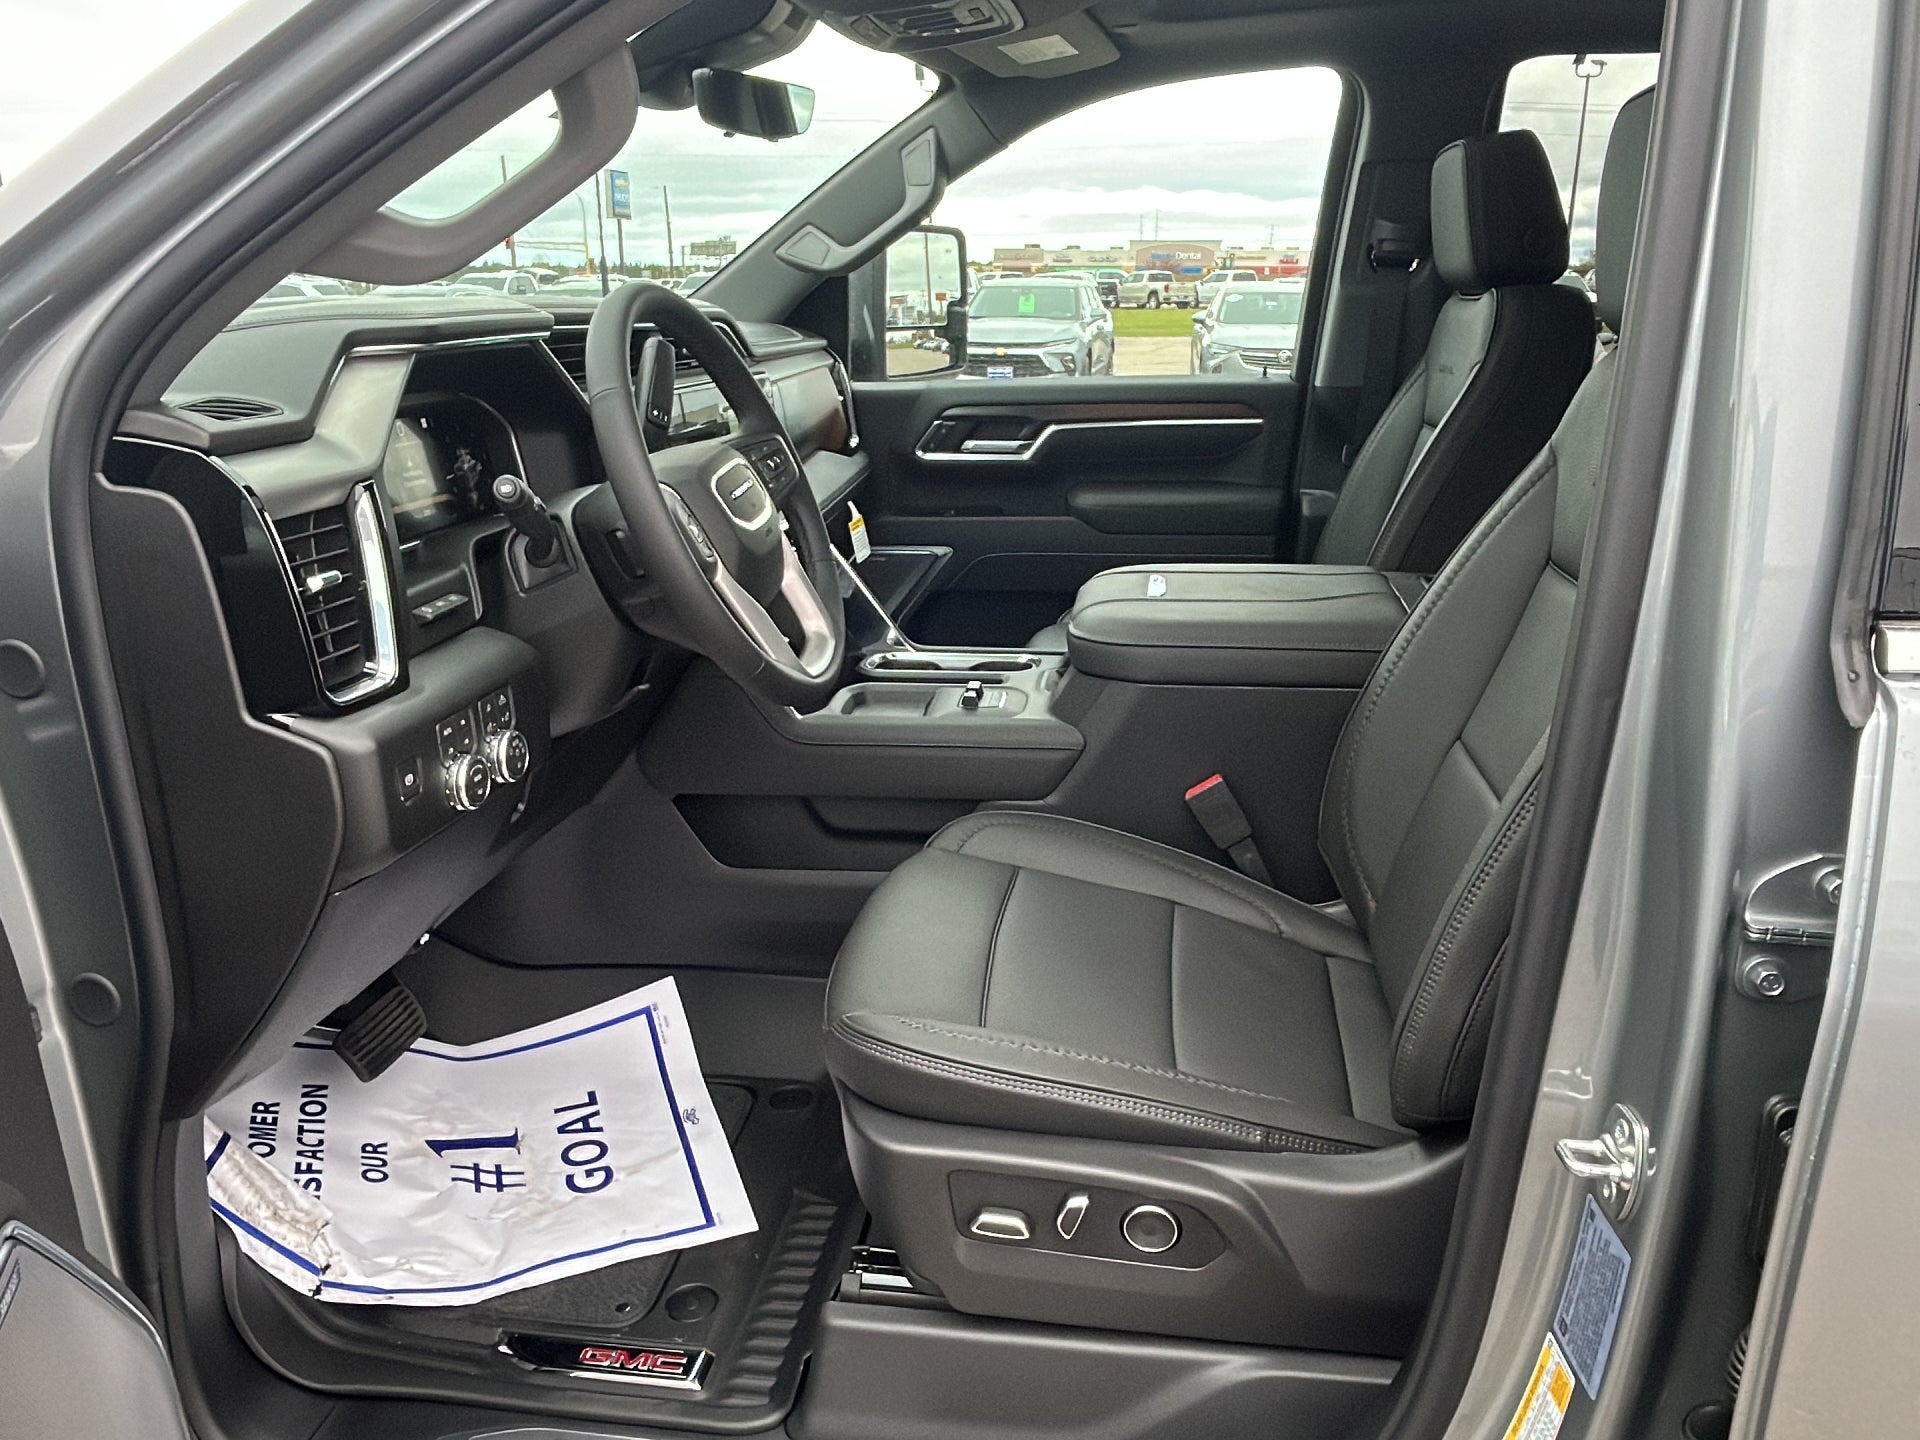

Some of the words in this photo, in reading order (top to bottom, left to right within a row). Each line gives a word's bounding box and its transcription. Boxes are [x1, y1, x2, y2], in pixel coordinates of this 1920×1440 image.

[1175, 251, 1202, 260] Dental
[293, 1084, 330, 1200] SFACTION
[360, 1142, 389, 1183] OUR
[424, 1127, 527, 1194] #1
[553, 1090, 615, 1194] GOAL
[578, 1346, 688, 1374] GMC
